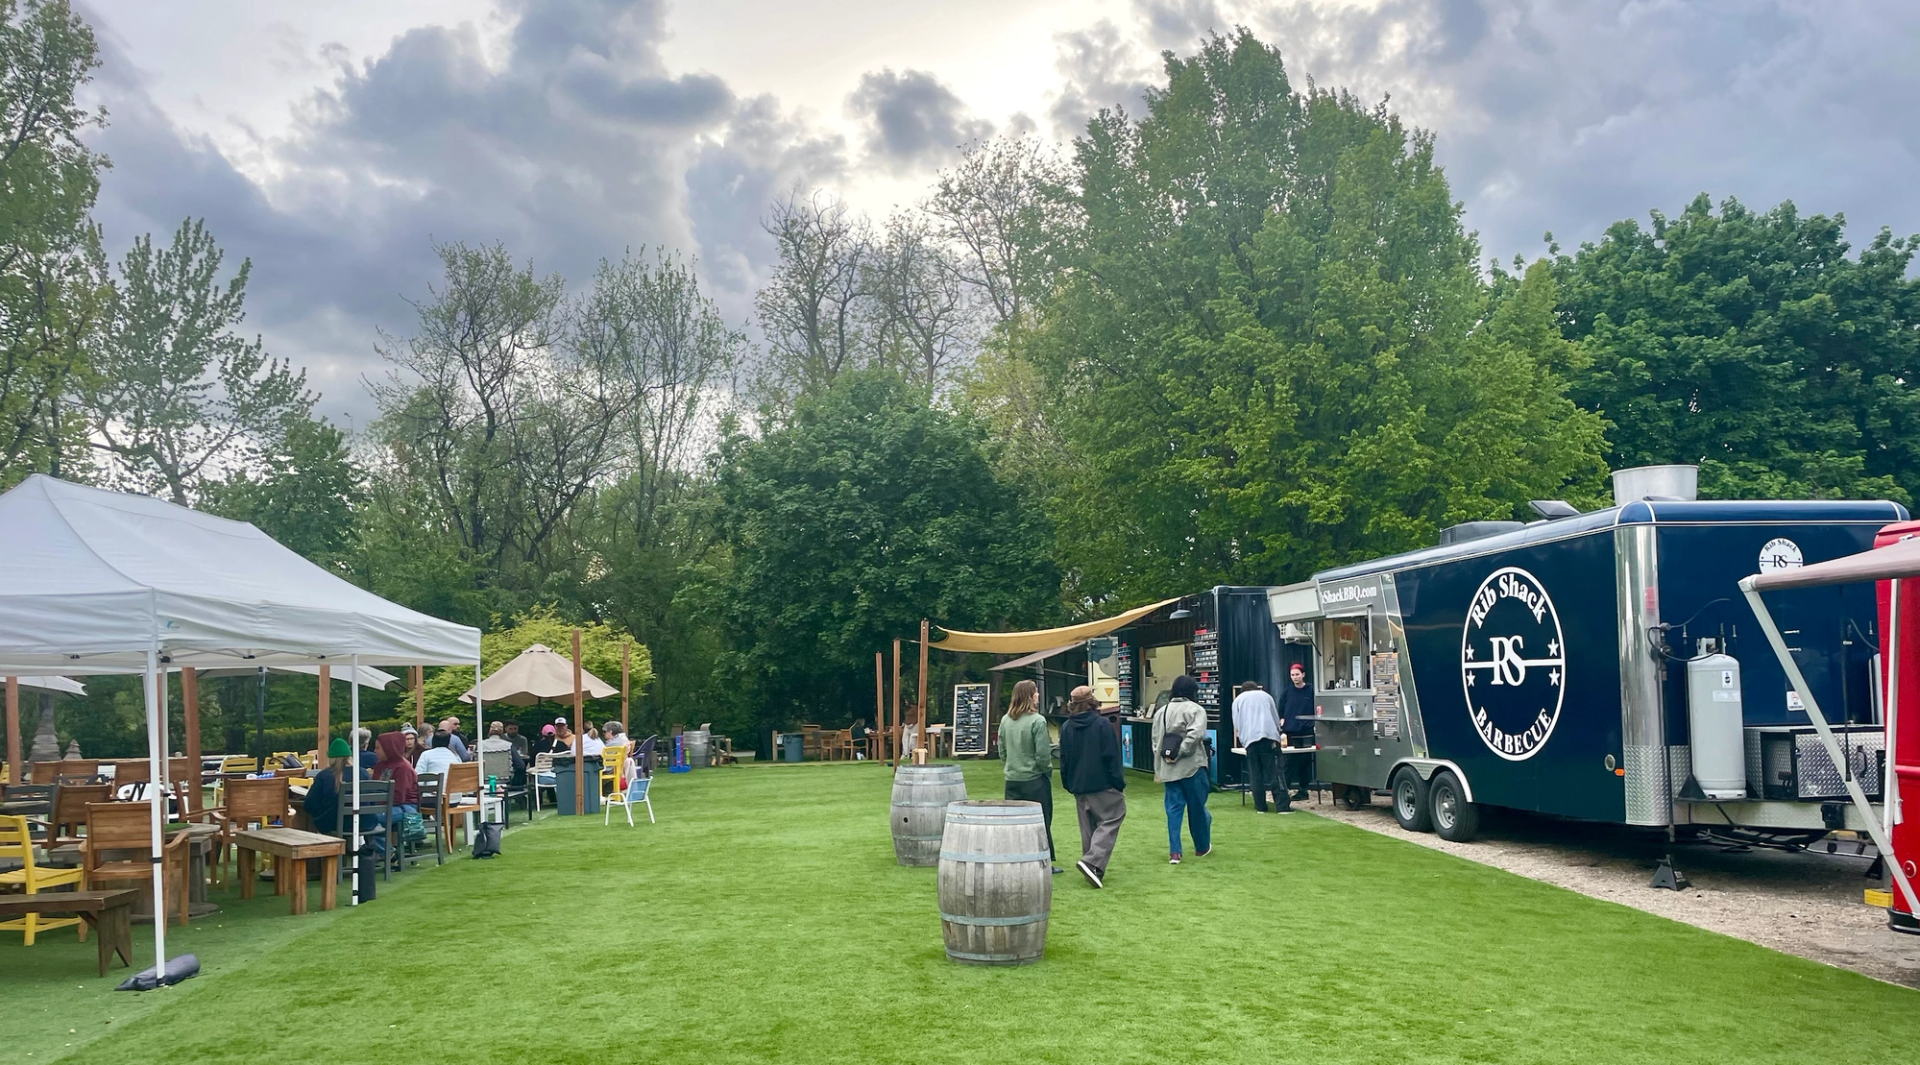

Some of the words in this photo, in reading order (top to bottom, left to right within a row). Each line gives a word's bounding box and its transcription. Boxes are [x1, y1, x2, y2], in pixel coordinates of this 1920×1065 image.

[1765, 542, 1776, 552] Rib
[1777, 540, 1797, 552] Shack
[1773, 555, 1788, 568] RS
[1321, 584, 1377, 603] ShackBBQ.com
[1471, 587, 1497, 629] Rib
[1499, 573, 1547, 624] Shack
[1489, 635, 1526, 687] RS
[1475, 706, 1553, 754] BARBECUE
